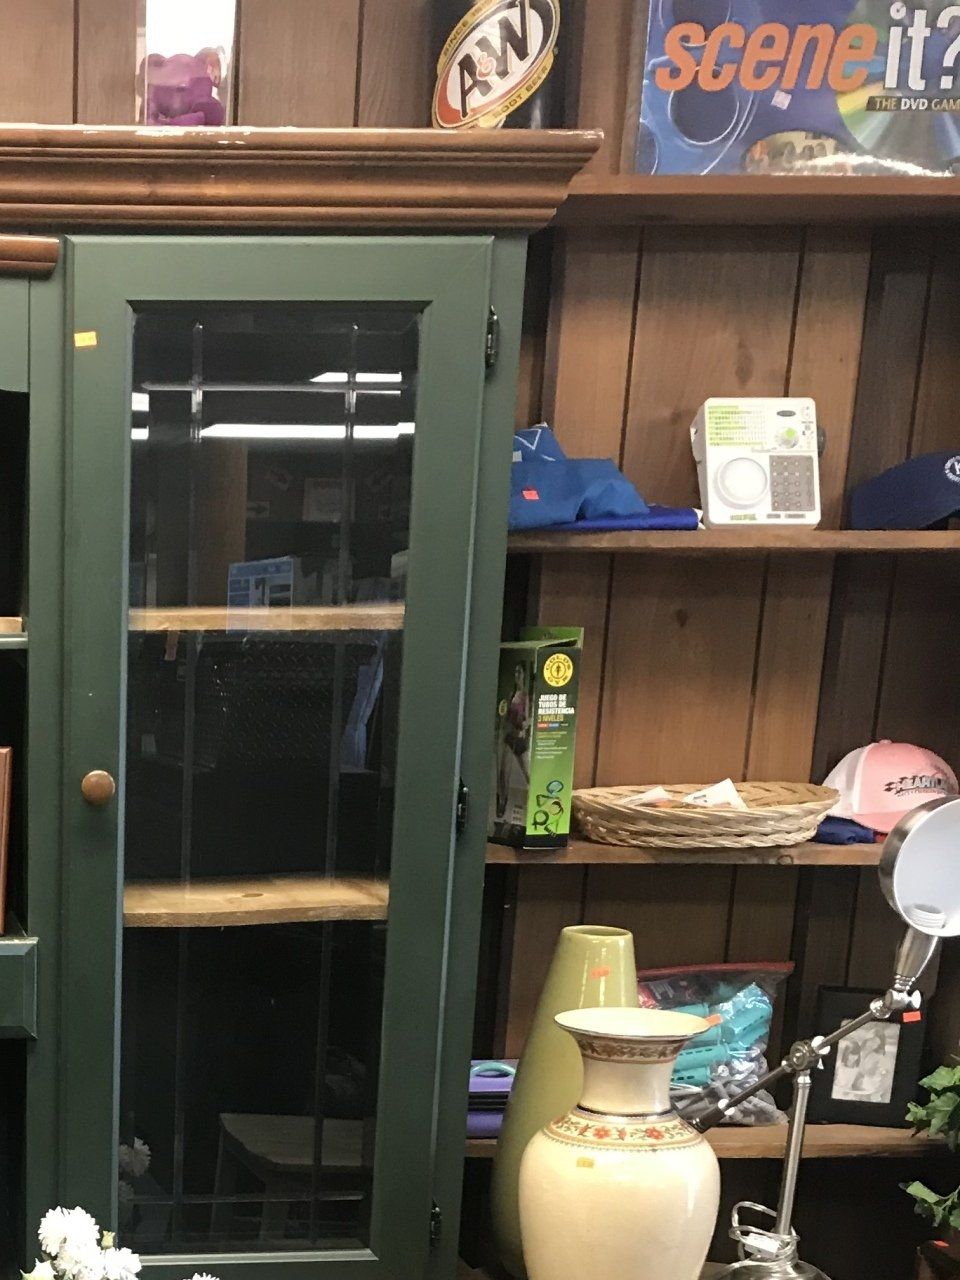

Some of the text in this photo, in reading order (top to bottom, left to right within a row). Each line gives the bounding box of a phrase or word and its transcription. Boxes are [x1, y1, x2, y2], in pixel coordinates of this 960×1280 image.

[458, 0, 530, 118] A&W
[654, 22, 878, 92] scene
[875, 98, 898, 109] THE
[900, 98, 929, 110] DVD
